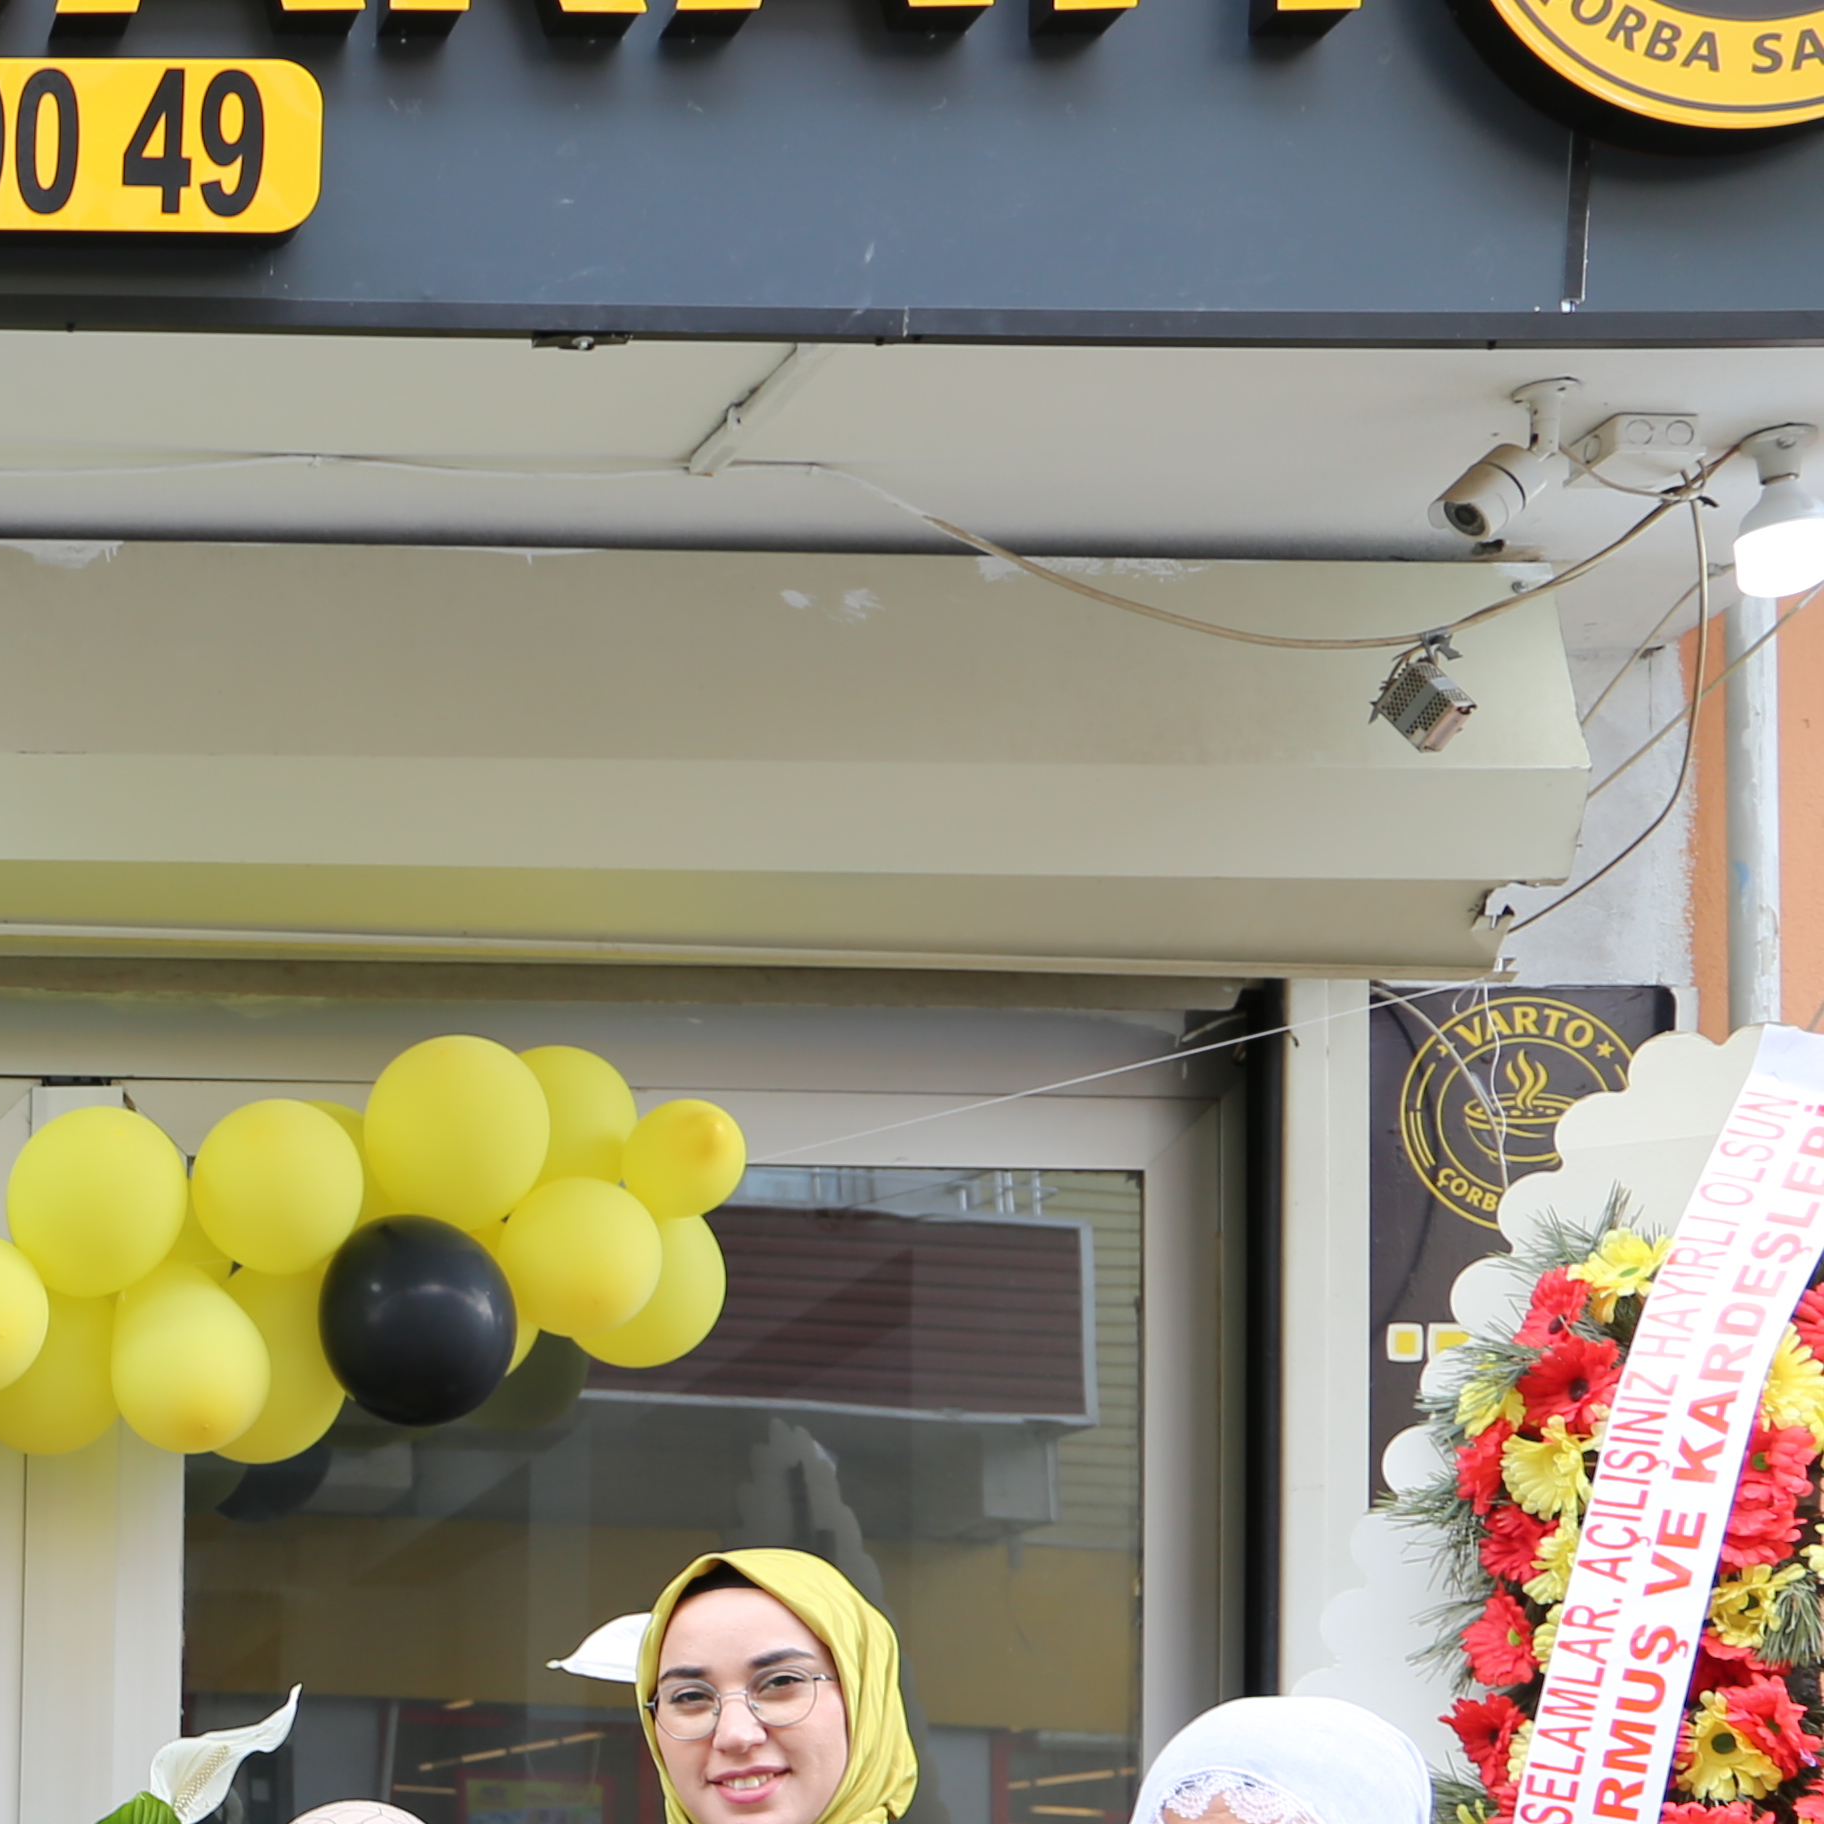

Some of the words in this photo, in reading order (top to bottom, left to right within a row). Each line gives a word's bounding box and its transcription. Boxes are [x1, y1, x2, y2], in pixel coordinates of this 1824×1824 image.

[1538, 0, 1721, 72] ORBA
[121, 69, 265, 218] 49
[1453, 1005, 1596, 1049] VARTO
[1436, 1167, 1499, 1212] ÇORB
[1635, 1212, 1743, 1360] HAYIRLI
[1698, 1090, 1800, 1207] OLSUN
[1643, 1508, 1708, 1597] VE
